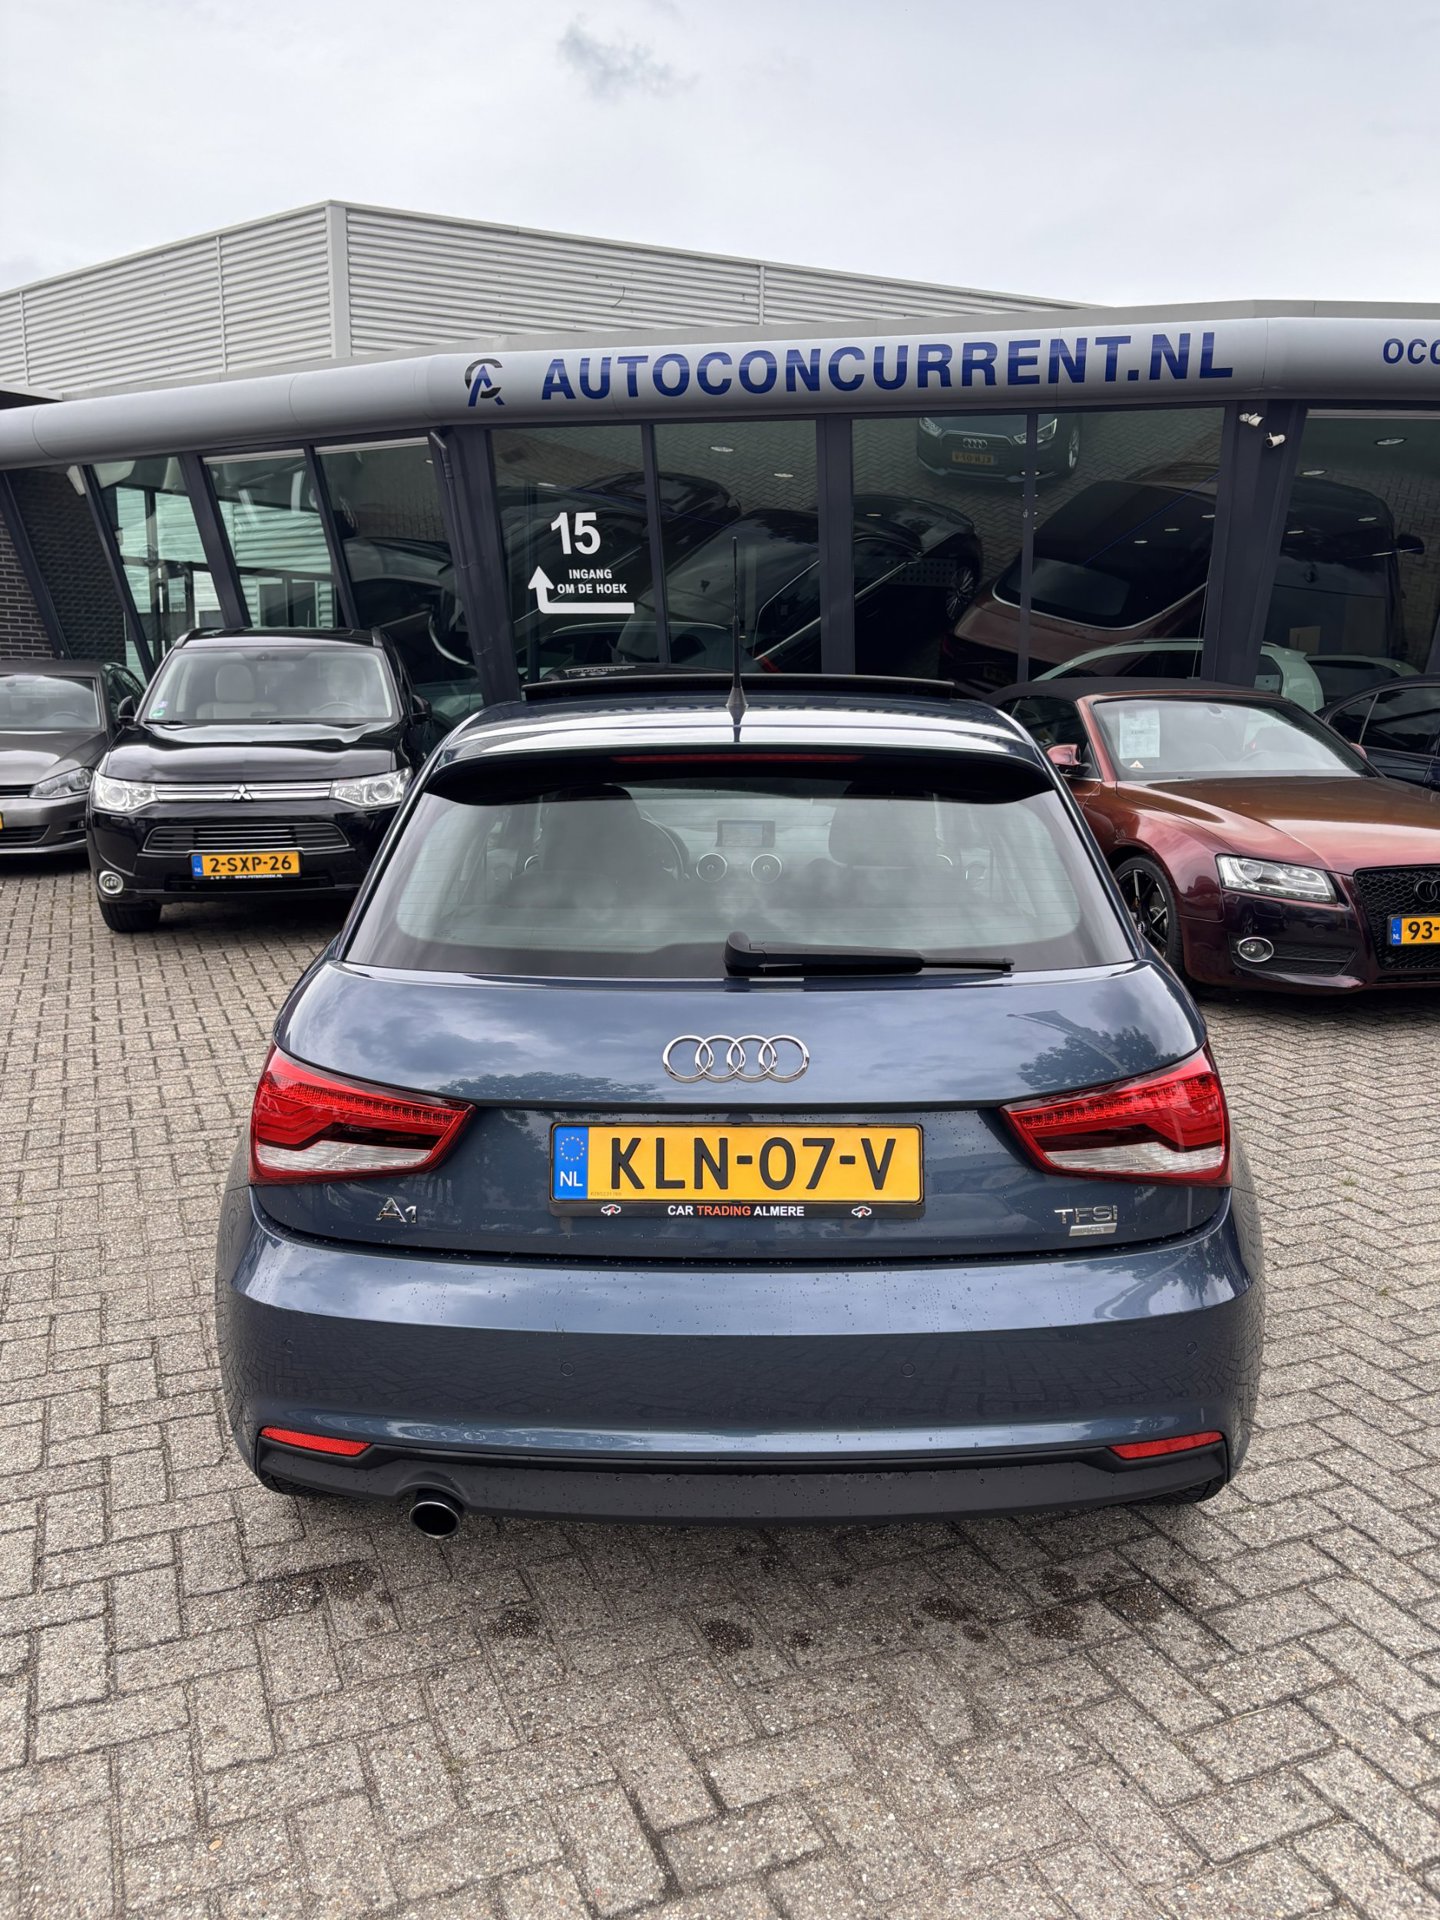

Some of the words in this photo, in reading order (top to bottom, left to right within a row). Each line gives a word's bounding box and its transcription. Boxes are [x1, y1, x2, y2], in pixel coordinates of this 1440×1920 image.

[541, 332, 1233, 400] AUTOCONCURRENT.NL
[551, 512, 601, 555] 15
[568, 569, 613, 579] INGANG
[557, 584, 575, 594] OM
[578, 584, 593, 594] DE
[596, 584, 628, 594] HOEK
[209, 855, 292, 873] 2-SXP-26
[611, 1137, 896, 1190] KLN-07-V
[560, 1171, 583, 1187] NL
[376, 1197, 417, 1223] A1
[667, 1205, 694, 1216] CAR
[697, 1205, 751, 1216] TRADING
[753, 1206, 805, 1216] ALMERE
